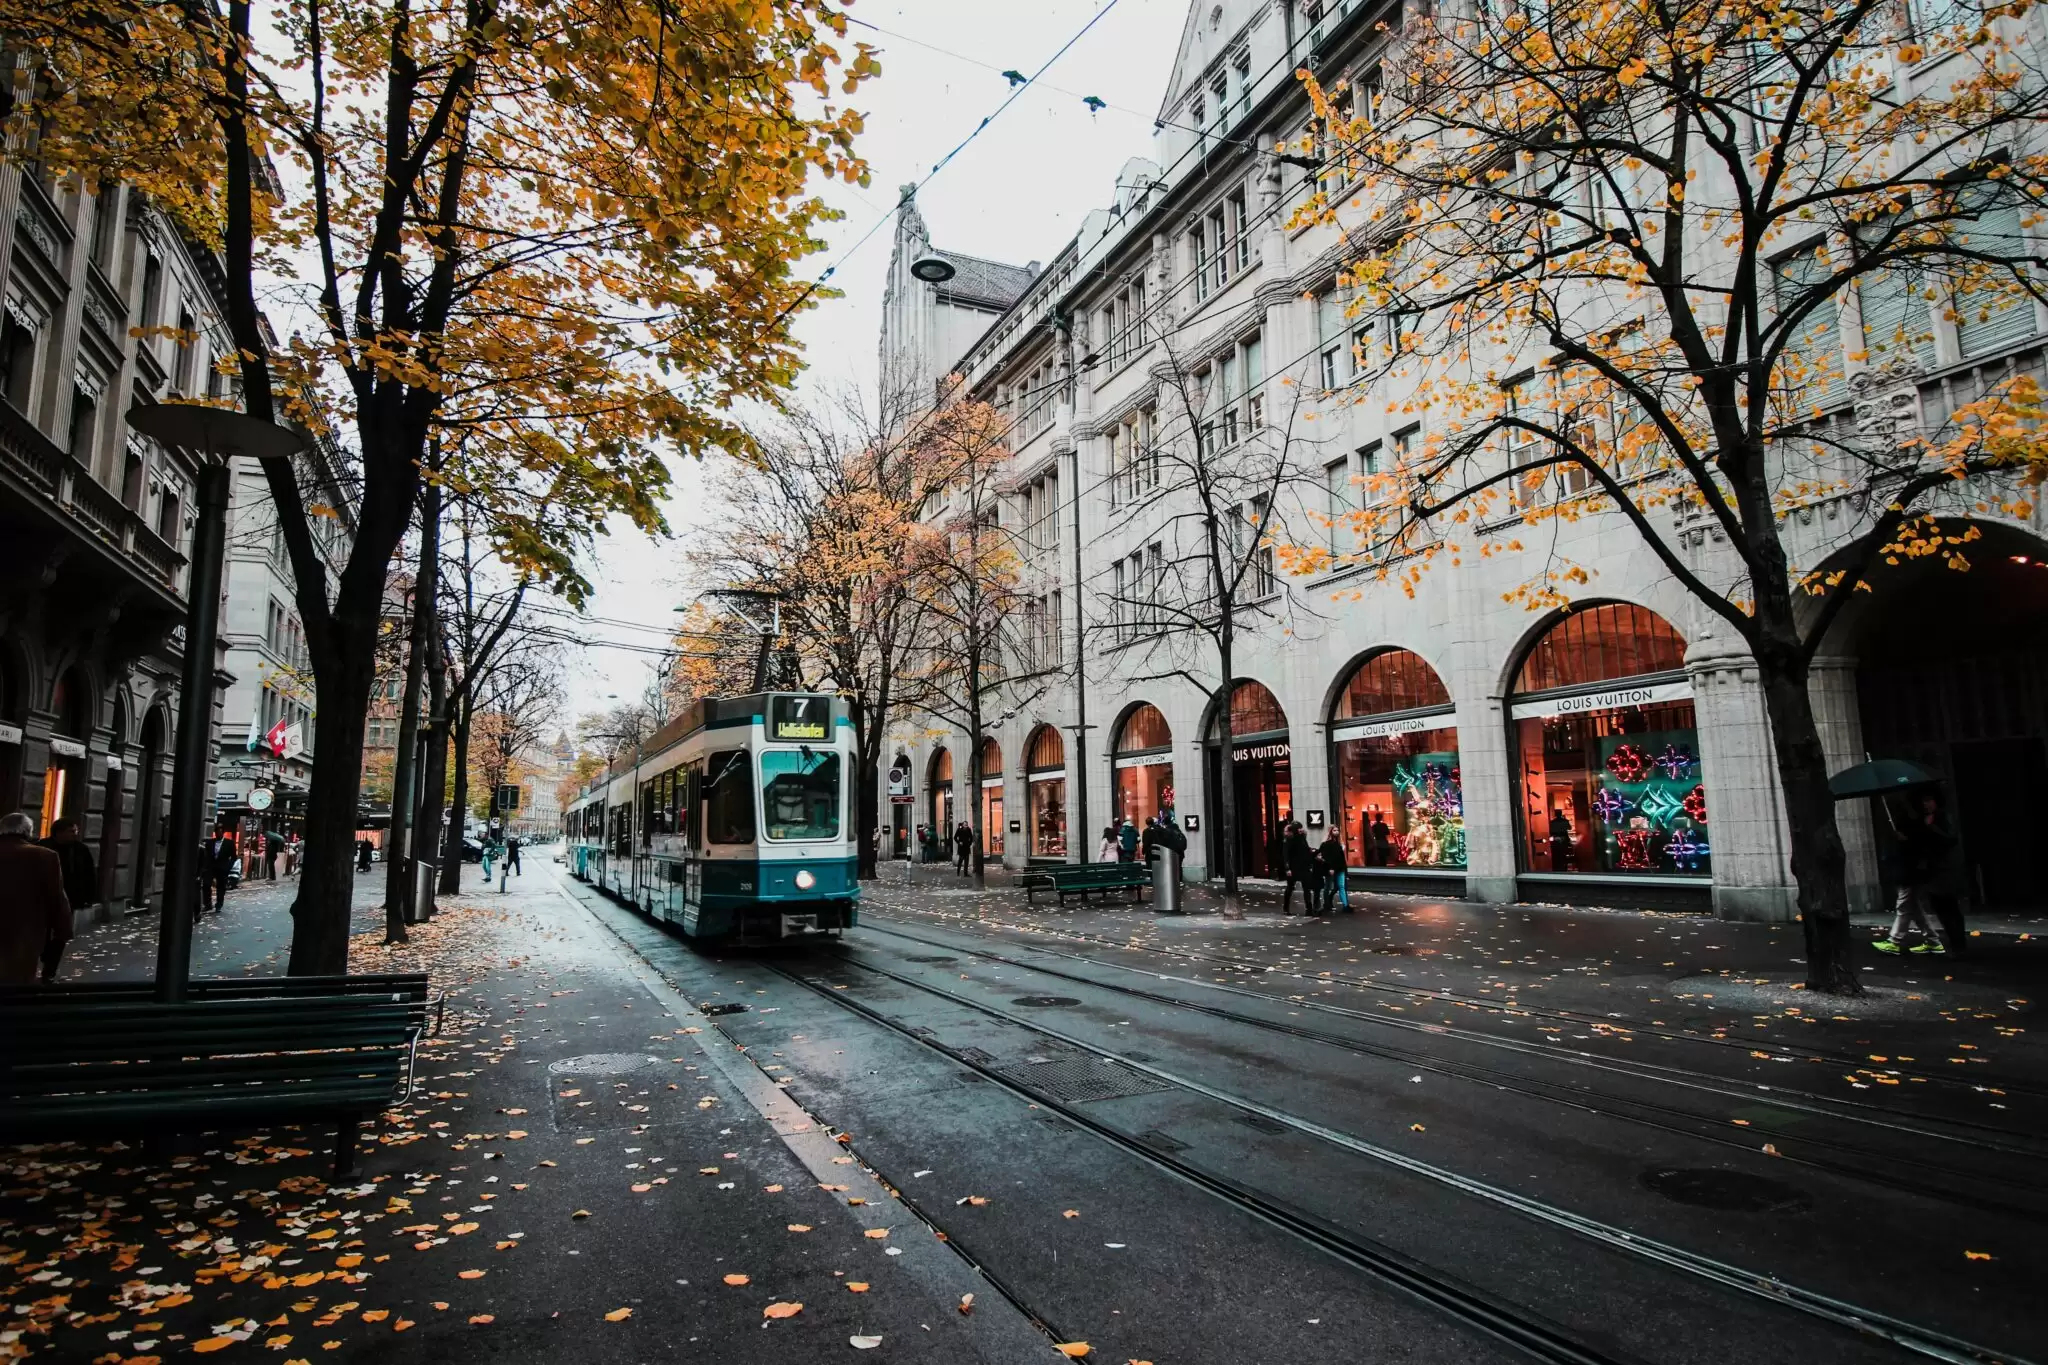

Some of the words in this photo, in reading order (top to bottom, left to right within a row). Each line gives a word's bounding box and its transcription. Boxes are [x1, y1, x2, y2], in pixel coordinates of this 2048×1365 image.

[794, 698, 809, 718] 7
[1557, 697, 1592, 711] LOUIS
[1596, 689, 1653, 706] VUITTON
[1362, 724, 1386, 736] LOUIS
[1388, 720, 1425, 732] VUITTON
[1231, 748, 1249, 762] UIS
